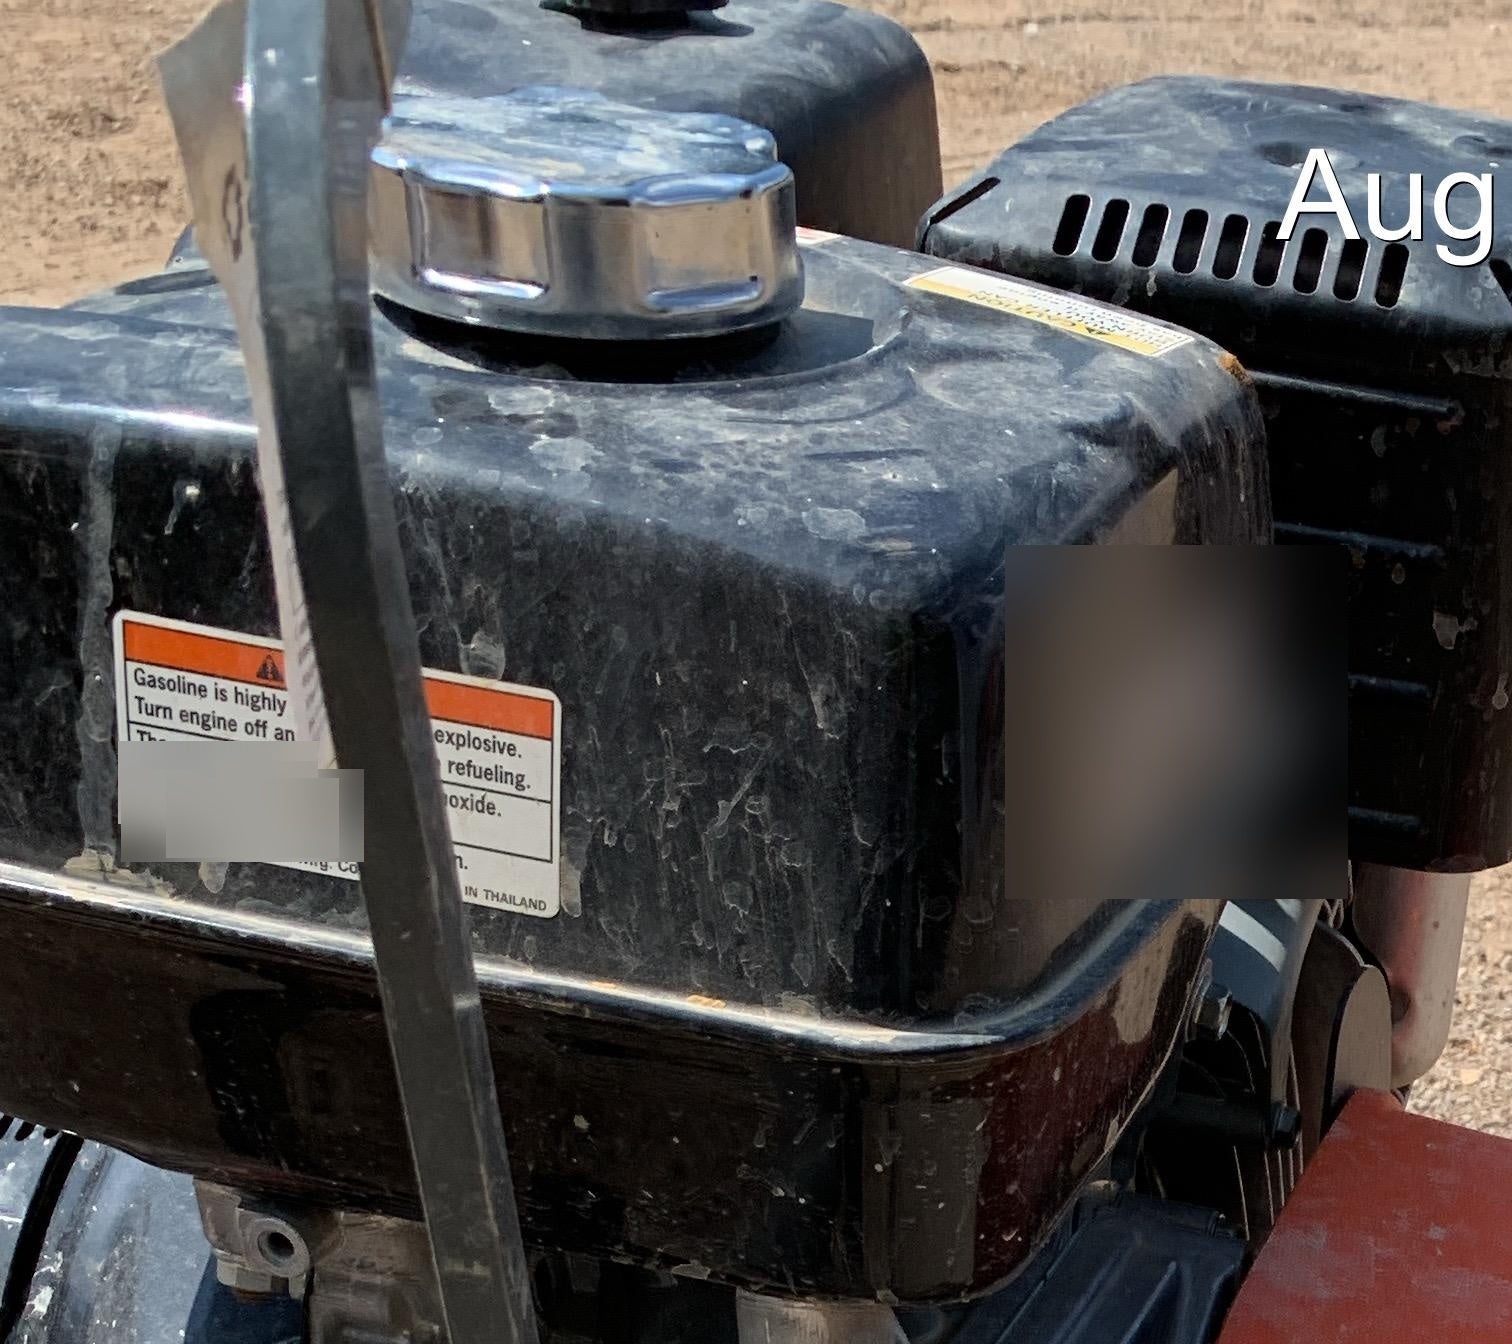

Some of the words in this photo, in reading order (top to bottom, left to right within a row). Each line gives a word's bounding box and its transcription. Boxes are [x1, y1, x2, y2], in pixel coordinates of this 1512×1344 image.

[133, 667, 208, 699] Gasoline
[213, 682, 229, 701] is
[234, 686, 288, 717] highly
[434, 728, 523, 758] explosive.
[134, 695, 173, 721] Turn
[179, 708, 238, 732] engine
[244, 720, 268, 738] off
[274, 725, 296, 741] an
[447, 758, 531, 791] refueling.
[464, 885, 478, 898] IN
[483, 888, 547, 912] THAILAND
